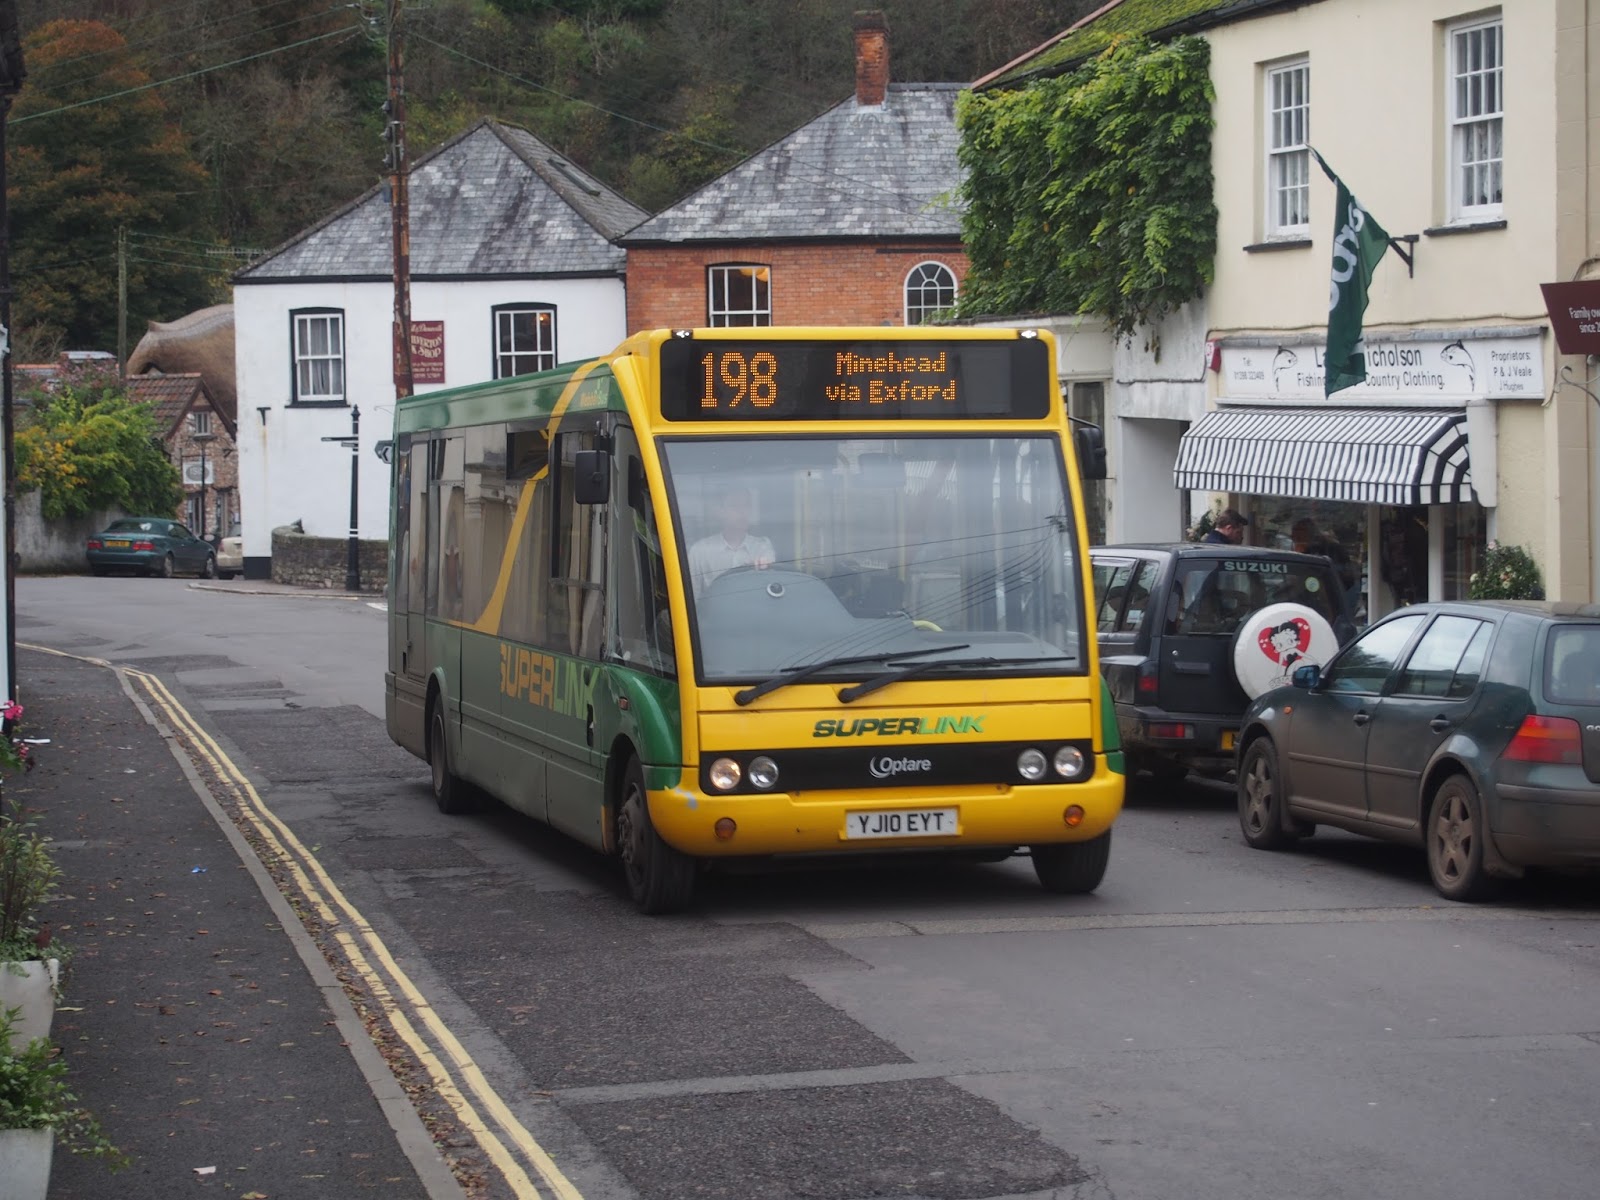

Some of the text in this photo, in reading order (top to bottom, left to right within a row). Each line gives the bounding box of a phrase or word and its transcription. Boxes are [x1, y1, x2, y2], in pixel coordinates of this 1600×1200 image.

[1579, 321, 1596, 333] since
[836, 352, 946, 375] Minehead
[1366, 344, 1422, 366] icholson
[701, 352, 777, 407] 198
[1365, 371, 1399, 390] Country
[825, 380, 956, 404] via Exford
[1224, 561, 1288, 573] SUZUKI
[812, 714, 988, 738] SUPERLINK
[878, 756, 932, 776] Optare
[858, 812, 944, 834] YJ10 EYT
